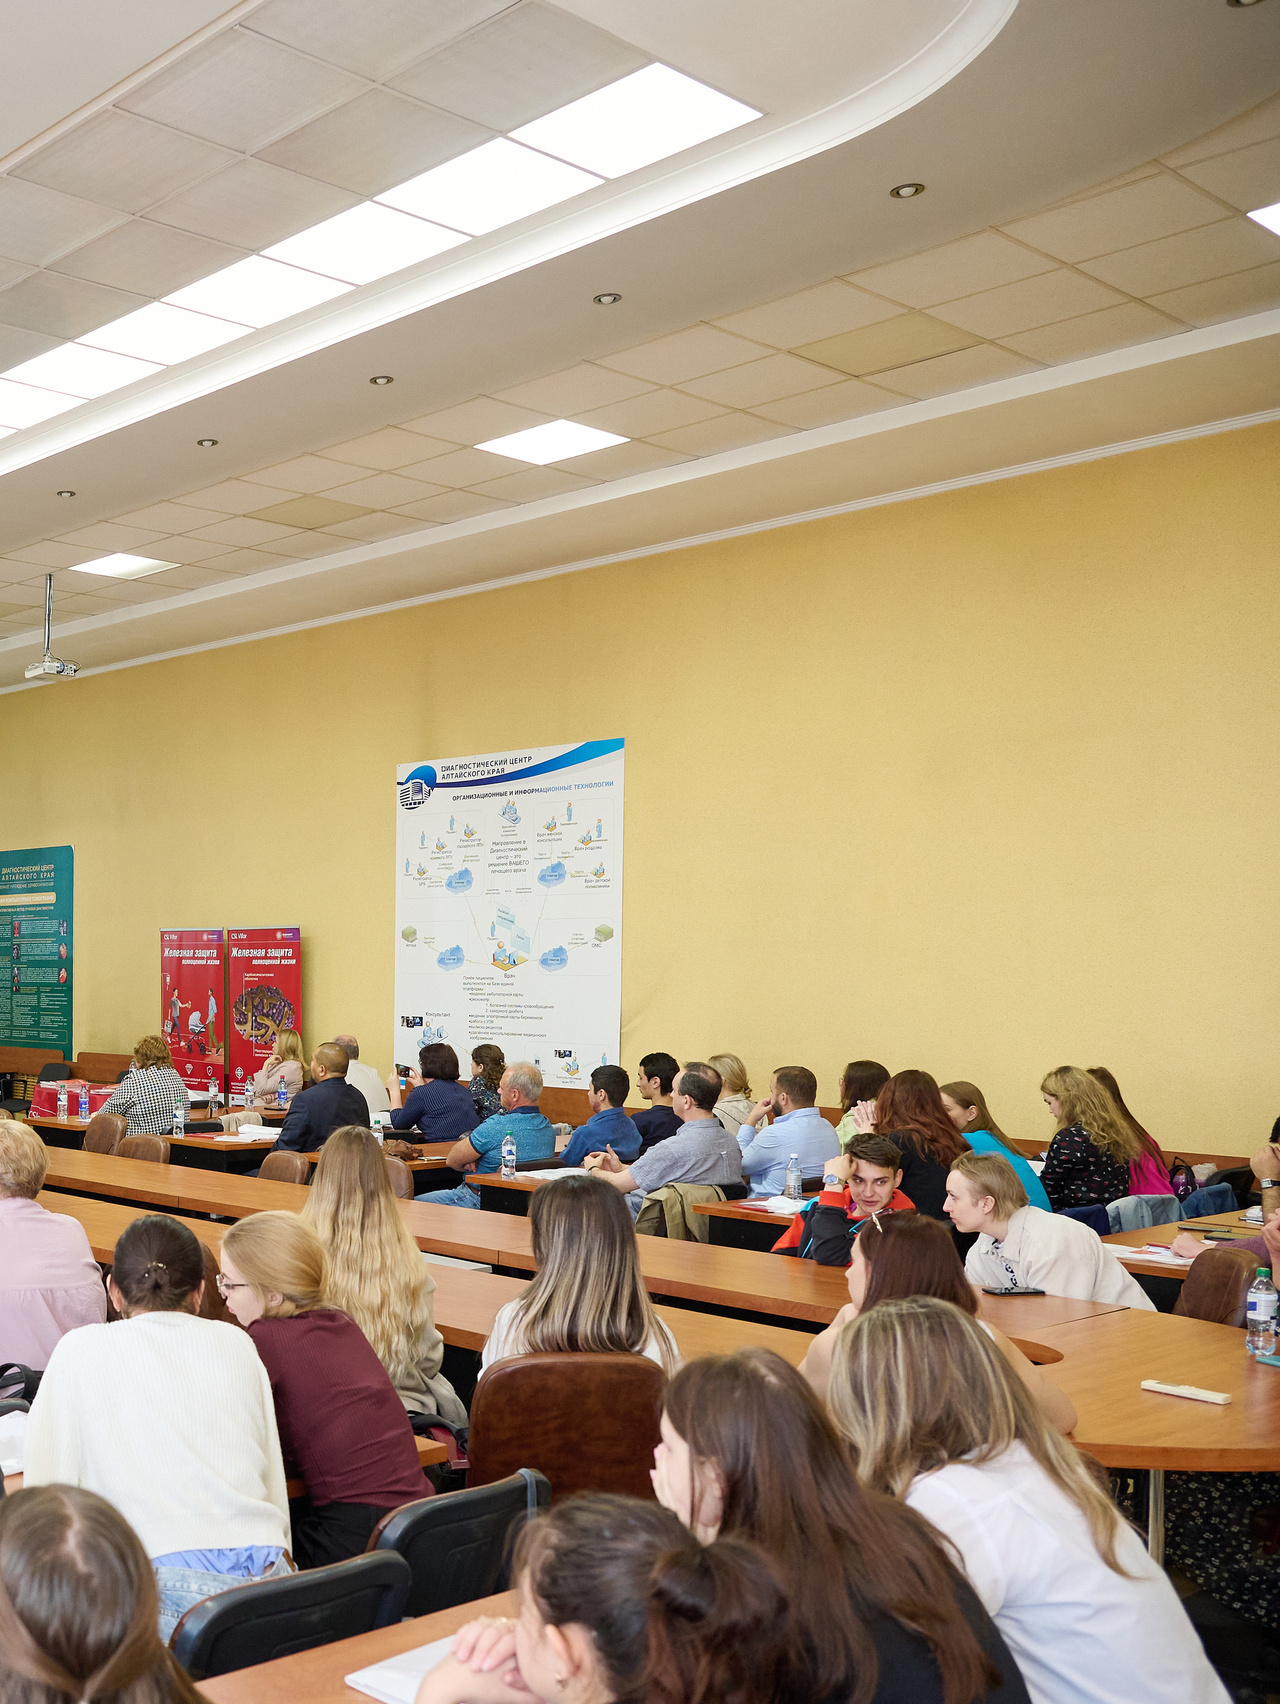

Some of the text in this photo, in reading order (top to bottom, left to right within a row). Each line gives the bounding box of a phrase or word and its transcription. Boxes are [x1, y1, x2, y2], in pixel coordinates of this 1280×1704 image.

[441, 756, 533, 772] ДИАГНОСТИЧЕСКИЙ ЦЕНТР
[441, 768, 505, 780] АЛТАЙСКОГО КРАЯ
[452, 791, 508, 802] ОРГАНИЗАЦИОННЫЕ
[514, 784, 572, 795] ИНФОРМАЦИОННЫЕ
[573, 781, 614, 791] ТЕХНОЛОГИИ
[1, 864, 40, 875] ДИАГНОСТИЧЕСКИЙ
[1, 872, 37, 881] АЛТАЙСКОГО
[163, 947, 217, 958] Железная защита
[231, 947, 293, 958] Железная защита
